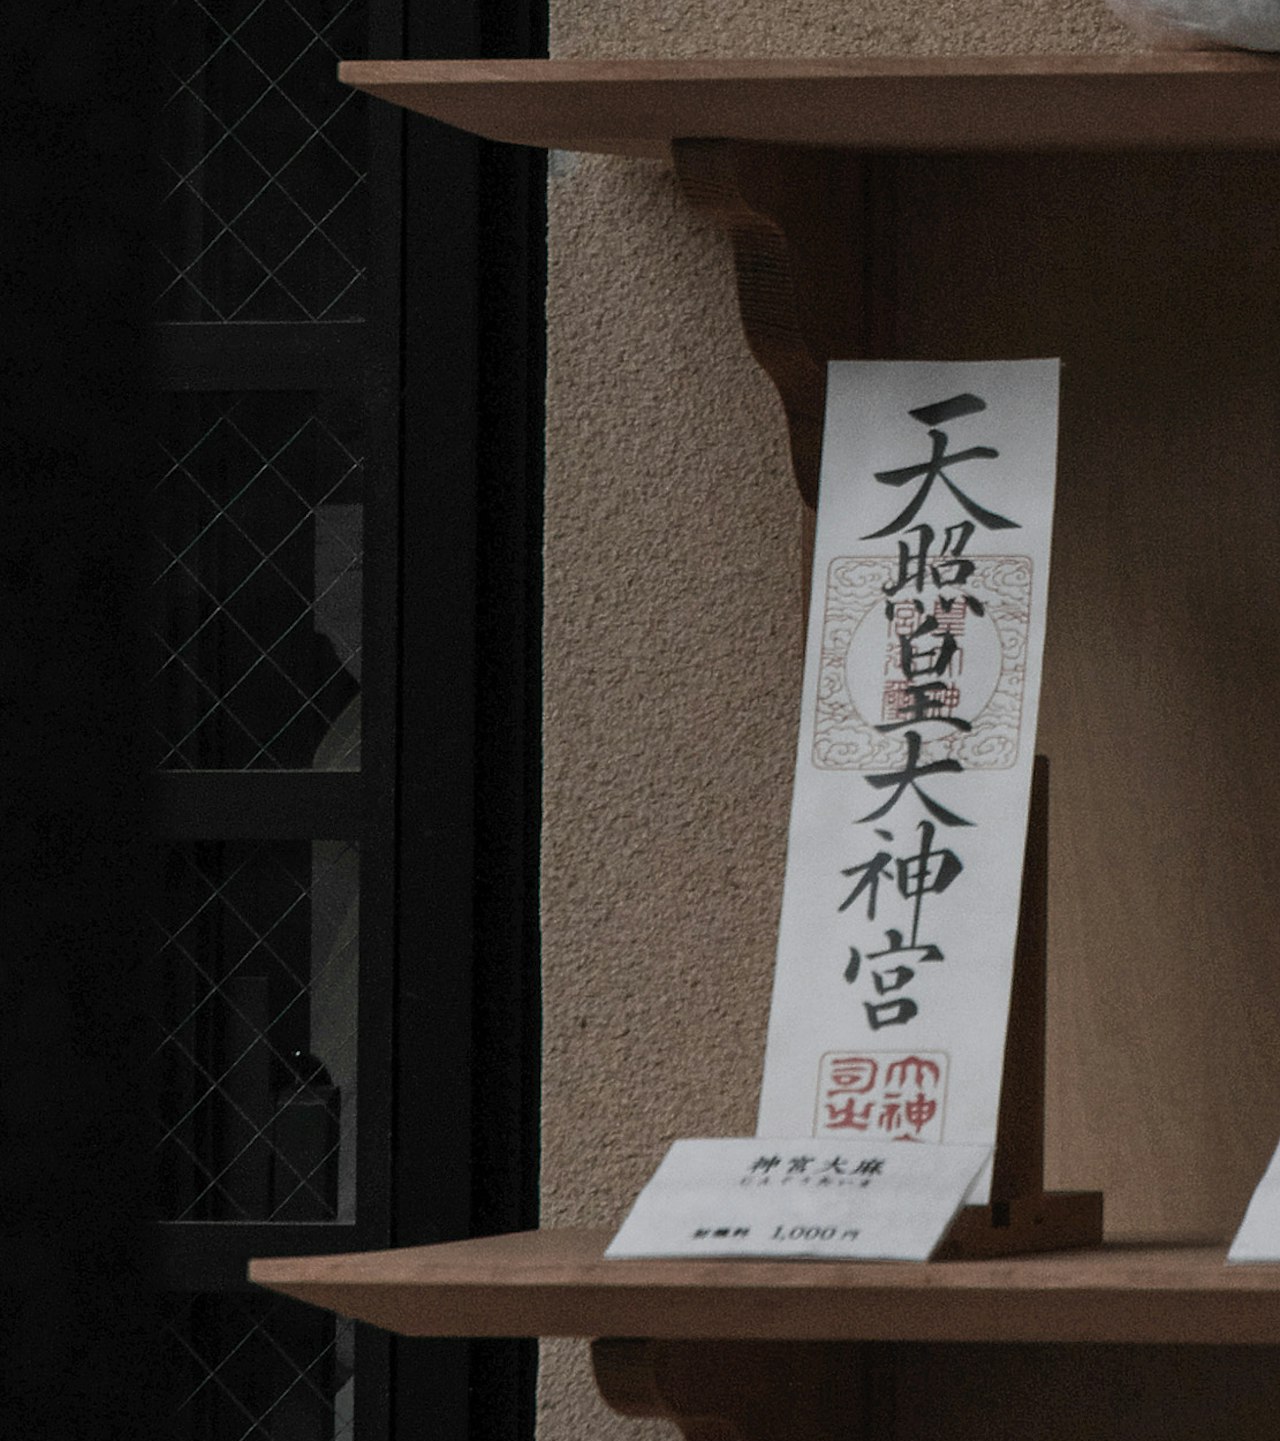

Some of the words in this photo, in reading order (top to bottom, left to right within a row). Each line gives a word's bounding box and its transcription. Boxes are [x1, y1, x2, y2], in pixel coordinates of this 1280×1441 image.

[838, 393, 1023, 1031] 天照皇大神宮
[751, 1155, 885, 1176] 神宮大麻
[771, 1225, 861, 1241] 1,000円
